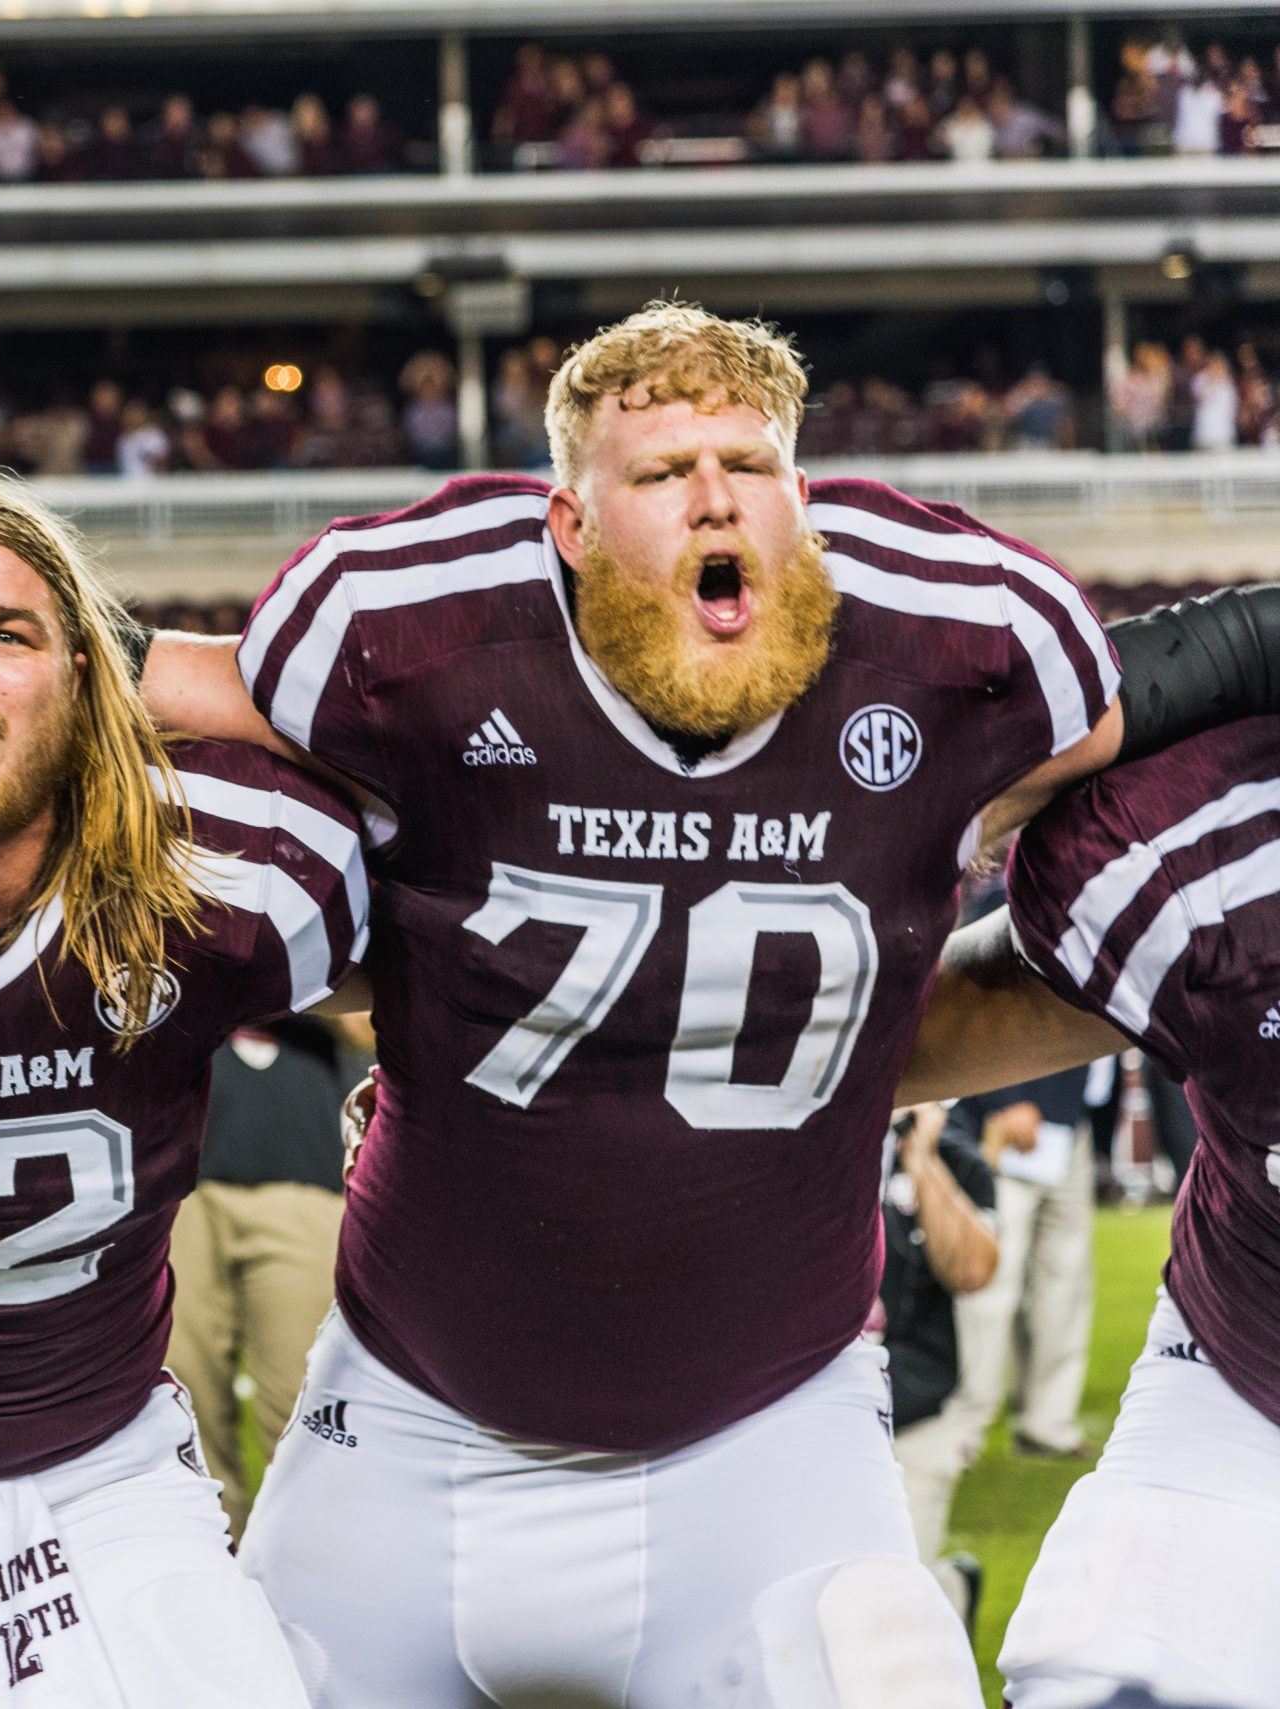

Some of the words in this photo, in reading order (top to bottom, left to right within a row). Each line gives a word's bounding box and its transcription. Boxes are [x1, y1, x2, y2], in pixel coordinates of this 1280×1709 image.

[463, 746, 536, 766] adidas
[848, 712, 914, 783] SEC
[548, 803, 711, 861] TEXAS
[727, 811, 832, 861] A&M
[461, 861, 879, 1130] 70
[0, 1047, 94, 1098] A&M
